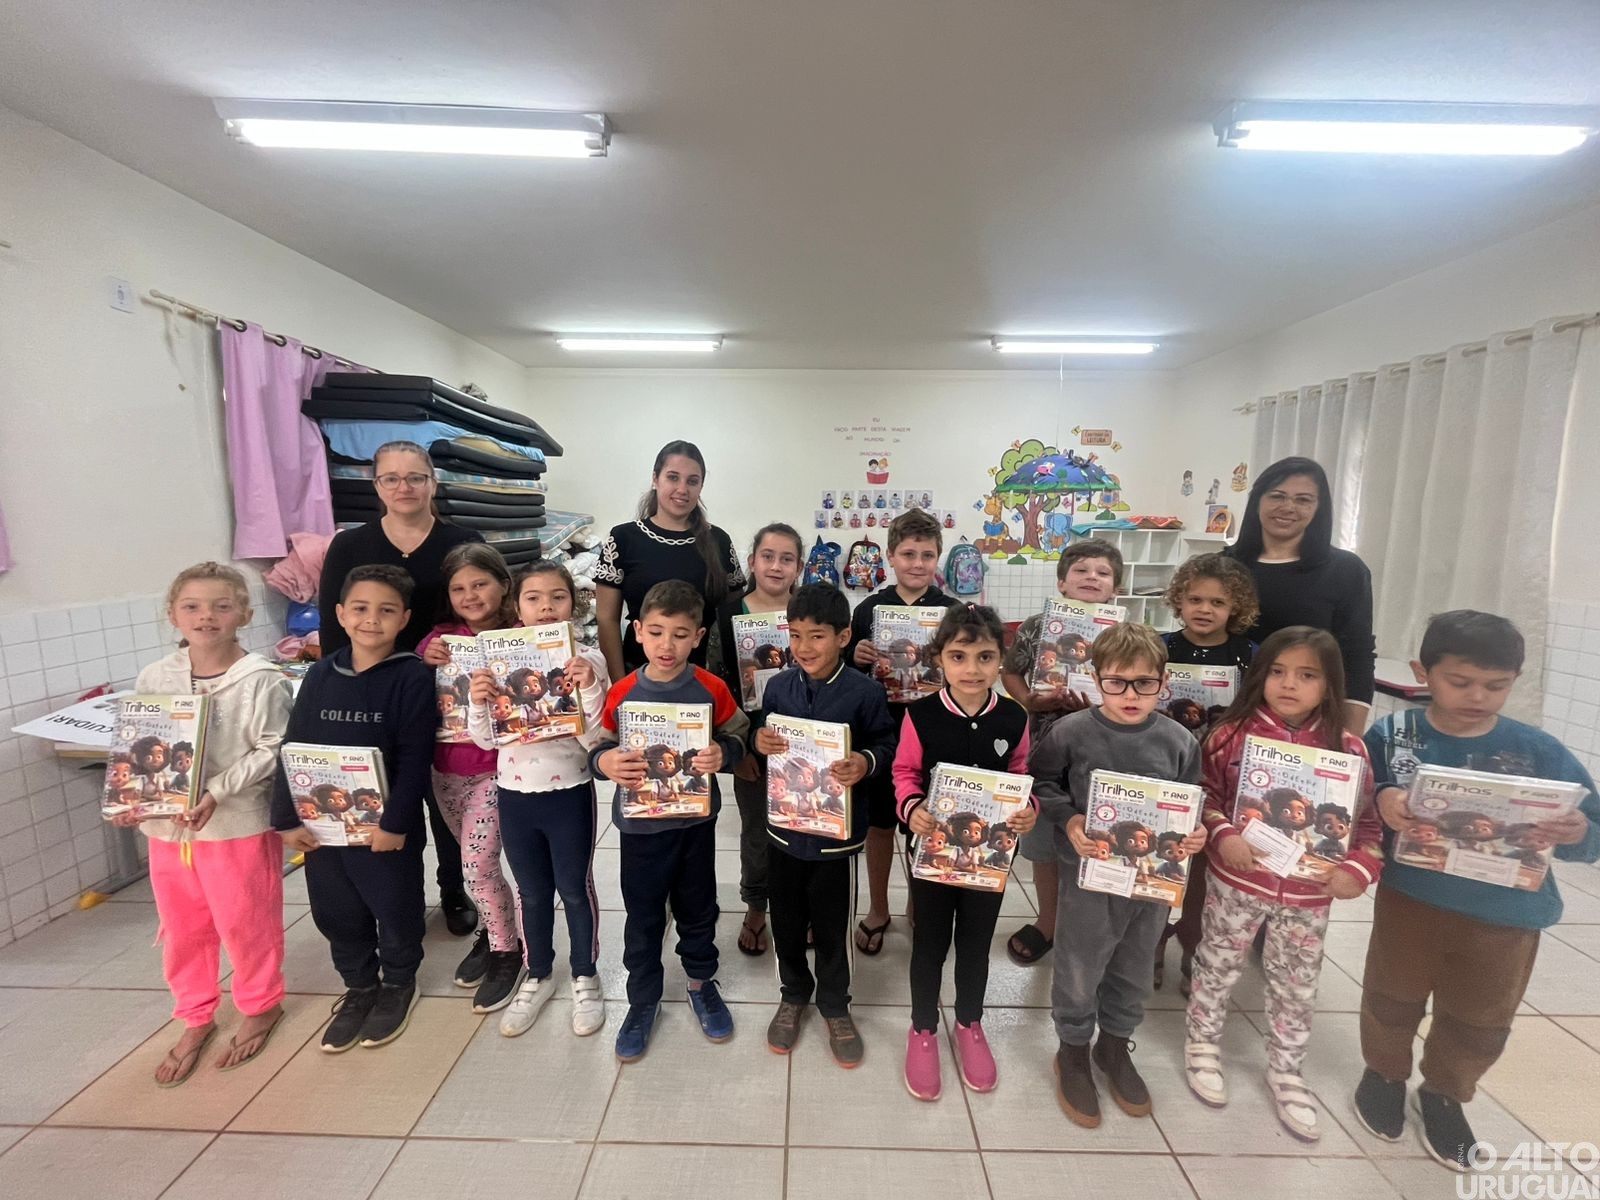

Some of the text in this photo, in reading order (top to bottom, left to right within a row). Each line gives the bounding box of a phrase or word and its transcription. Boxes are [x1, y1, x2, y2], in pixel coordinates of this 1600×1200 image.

[1053, 602, 1085, 616] Trilhas
[880, 610, 911, 621] Trilhas
[739, 619, 769, 629] Trilhas
[544, 629, 560, 637] ANO
[446, 642, 479, 653] Trilhas
[485, 637, 526, 650] Trilhas
[125, 701, 161, 713] Trilhas
[628, 711, 667, 723] Trilhas
[45, 714, 114, 733] CUIDAR!
[771, 723, 805, 737] Trilhas
[1253, 743, 1302, 764] Trilhas
[289, 754, 329, 766] Trilhas
[1328, 758, 1348, 768] ANO
[943, 775, 983, 791] Trilhas
[1005, 784, 1022, 792] ANO
[1428, 779, 1493, 796] Trilhas
[1099, 782, 1145, 799] Trilhas
[1170, 791, 1189, 800] ANO
